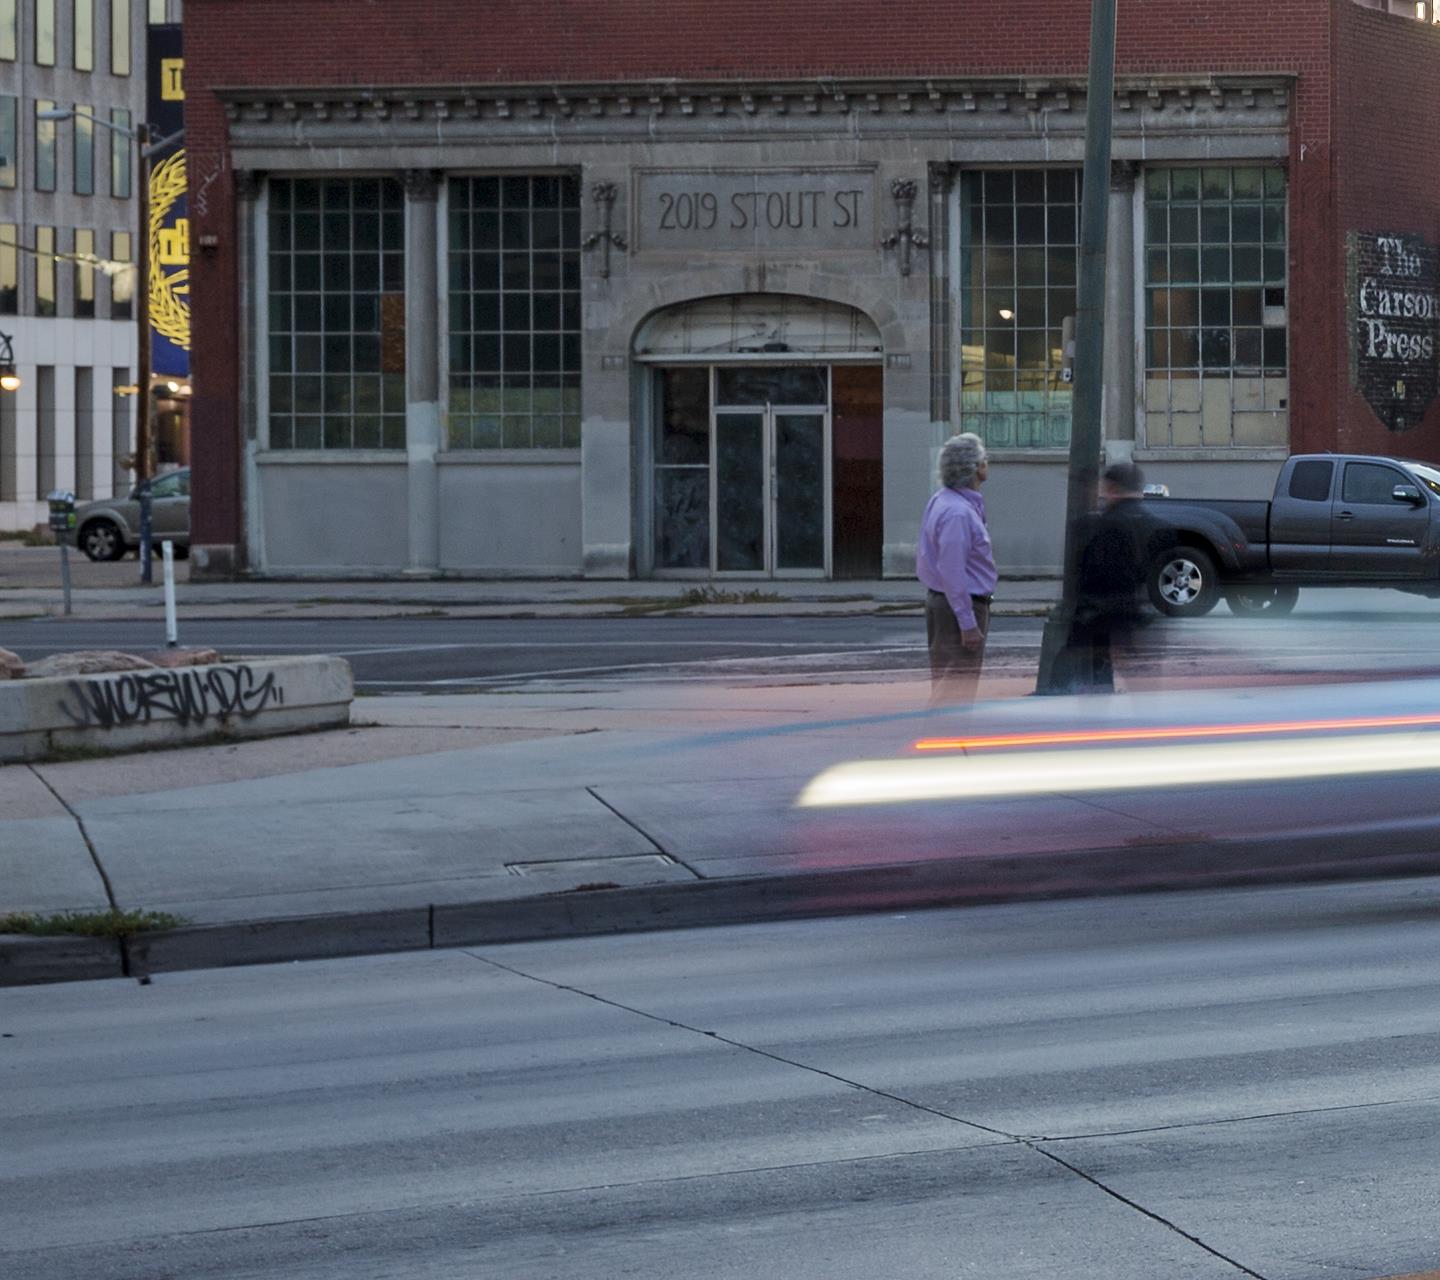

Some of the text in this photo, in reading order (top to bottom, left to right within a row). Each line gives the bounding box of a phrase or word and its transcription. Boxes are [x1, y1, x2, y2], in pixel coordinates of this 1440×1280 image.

[658, 190, 864, 230] 2019 STOUT ST
[1377, 236, 1422, 278] The
[1357, 317, 1434, 360] Press
